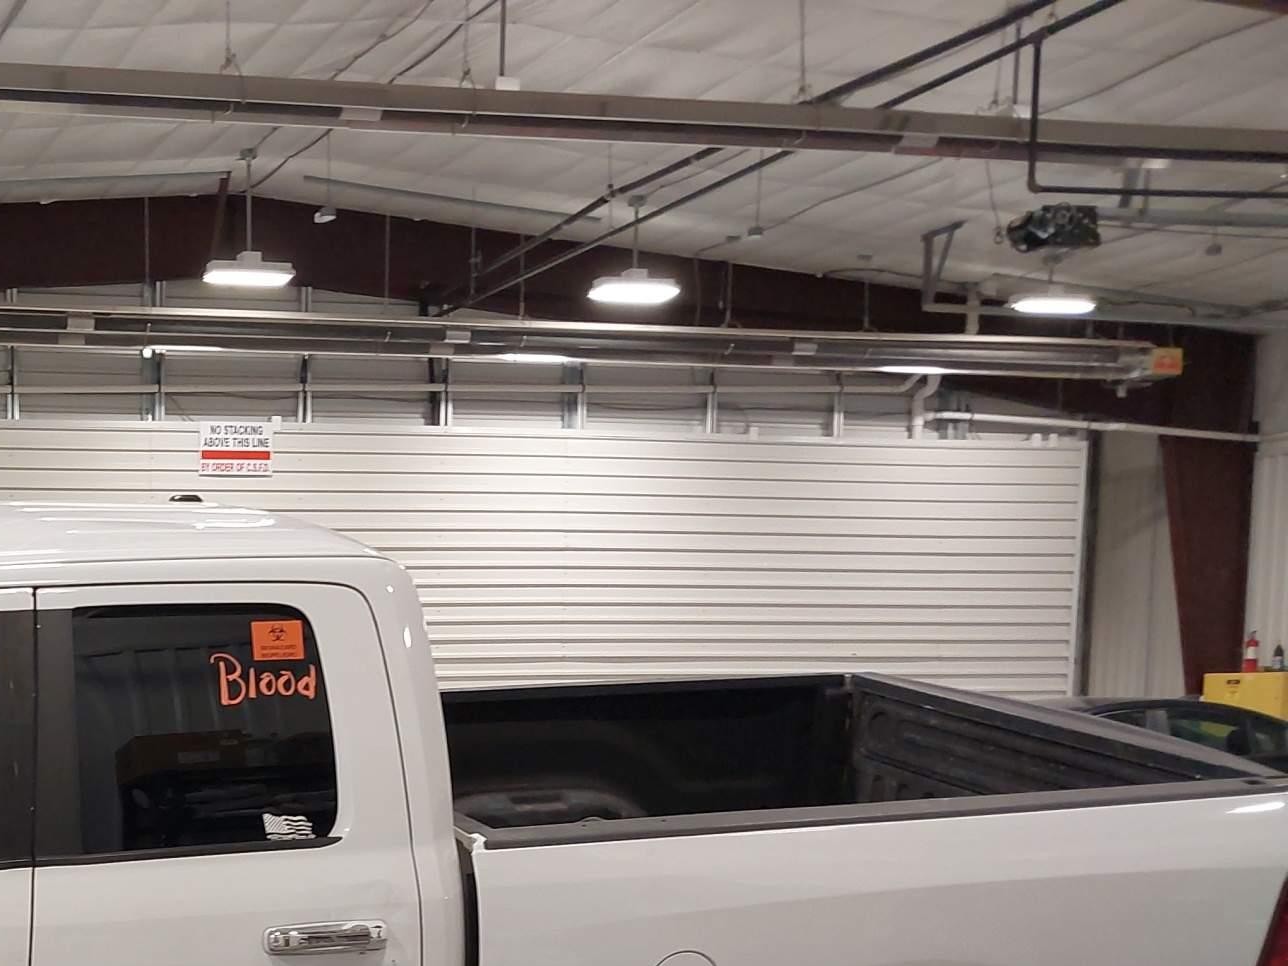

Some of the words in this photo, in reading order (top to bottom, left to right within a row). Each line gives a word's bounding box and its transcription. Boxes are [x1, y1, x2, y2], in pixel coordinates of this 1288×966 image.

[210, 425, 222, 435] NO
[224, 425, 264, 436] STACKING
[202, 437, 230, 448] ABOVE
[232, 437, 250, 448] THIS
[252, 438, 270, 448] LINE
[210, 653, 316, 706] Blood
